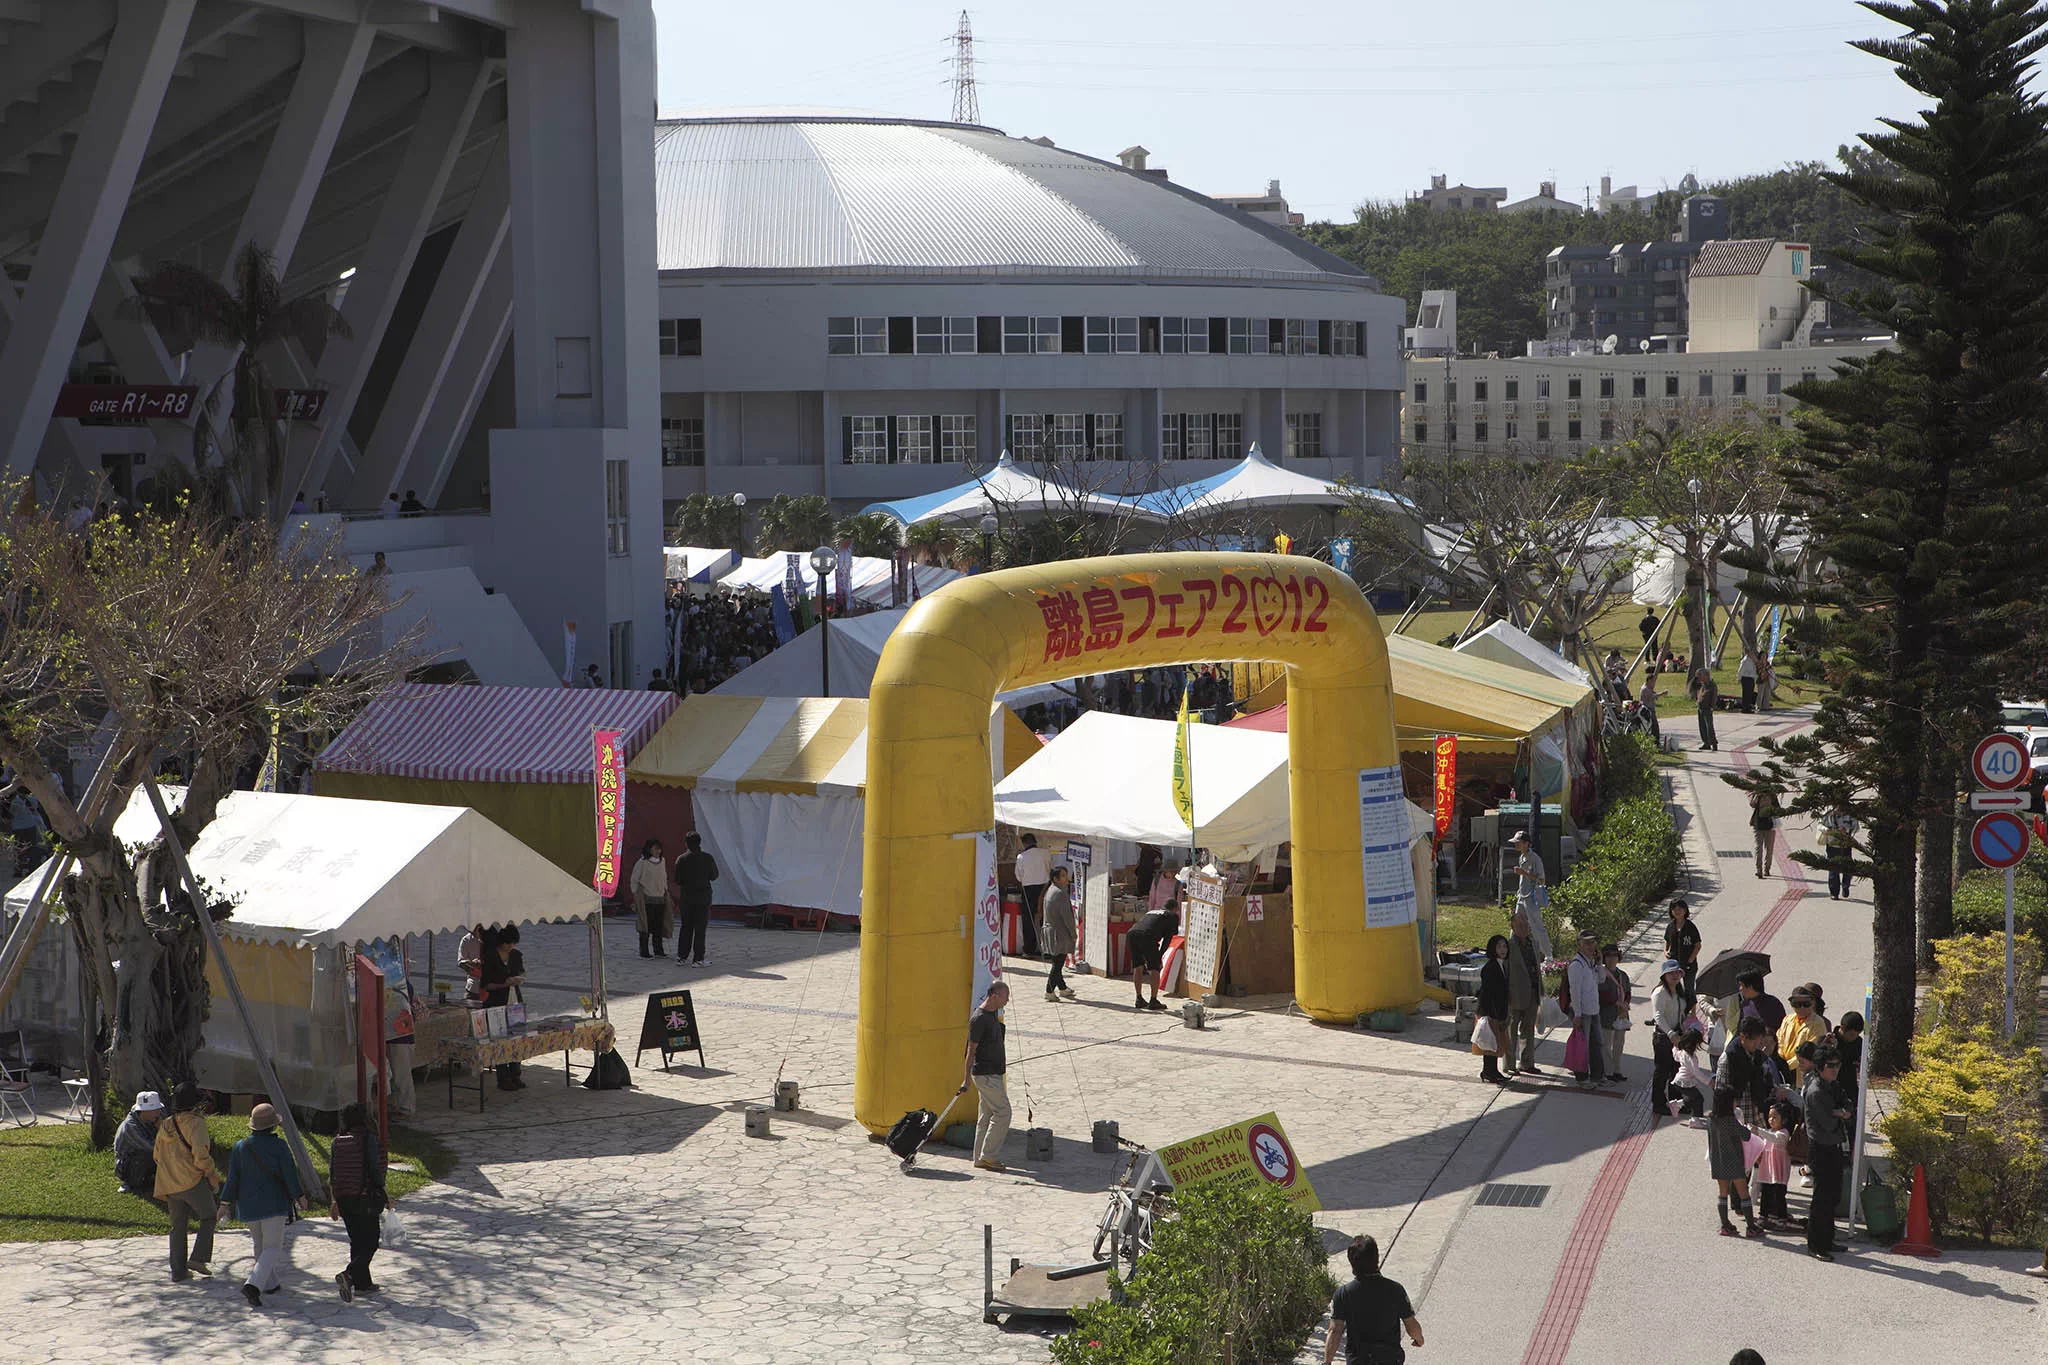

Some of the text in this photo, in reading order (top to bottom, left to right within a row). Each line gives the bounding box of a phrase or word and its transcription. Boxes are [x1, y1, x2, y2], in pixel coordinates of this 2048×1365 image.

[89, 400, 118, 413] GATE
[1986, 750, 2017, 775] 40
[1247, 896, 1262, 919] 本
[664, 1010, 689, 1031] 本
[1162, 1128, 1243, 1167] 公園内へのオートバイの
